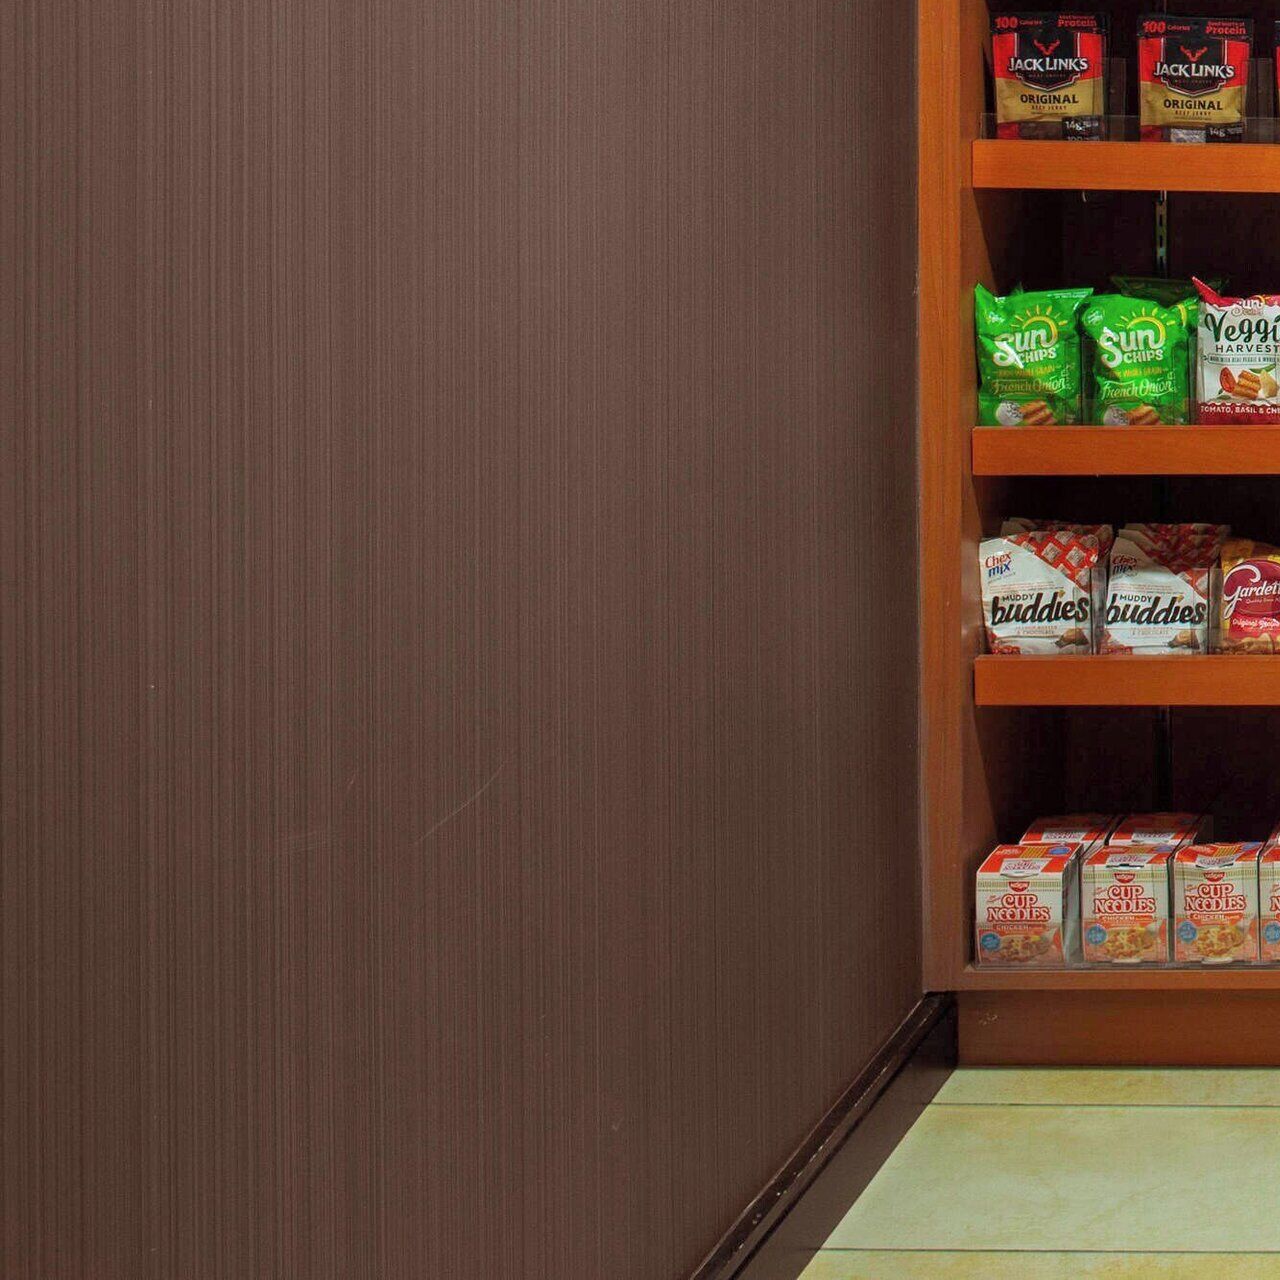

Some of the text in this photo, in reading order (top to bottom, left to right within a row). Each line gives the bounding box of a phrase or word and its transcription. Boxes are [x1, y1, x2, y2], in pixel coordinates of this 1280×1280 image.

[995, 17, 1017, 28] 100
[1143, 22, 1165, 33] 100
[1206, 26, 1246, 35] Protein
[1009, 58, 1088, 71] JACK LINK'S
[1154, 63, 1234, 76] JACK LINK'S
[1020, 95, 1079, 104] ORIGINAL
[1163, 99, 1222, 110] ORIGINAL
[993, 327, 1057, 367] Sun
[1100, 326, 1164, 367] Sun
[1020, 348, 1057, 362] CHIPS
[1123, 349, 1163, 362] CHIPS
[992, 381, 1032, 394] French
[1102, 378, 1174, 400] French Onion
[985, 552, 1011, 568] Chex
[1112, 555, 1137, 566] Chex
[988, 562, 1011, 577] mix
[1002, 593, 1034, 602] MUDDY
[1119, 594, 1152, 602] MUDDY
[991, 591, 1089, 625] buddies
[1106, 593, 1206, 625] buddies
[1108, 886, 1143, 899] CUP
[1198, 884, 1234, 898] CUP
[1002, 894, 1037, 908] CUP
[1094, 899, 1155, 913] NOODLES
[1185, 897, 1246, 912] NOODLES
[988, 907, 1050, 921] NOODLES
